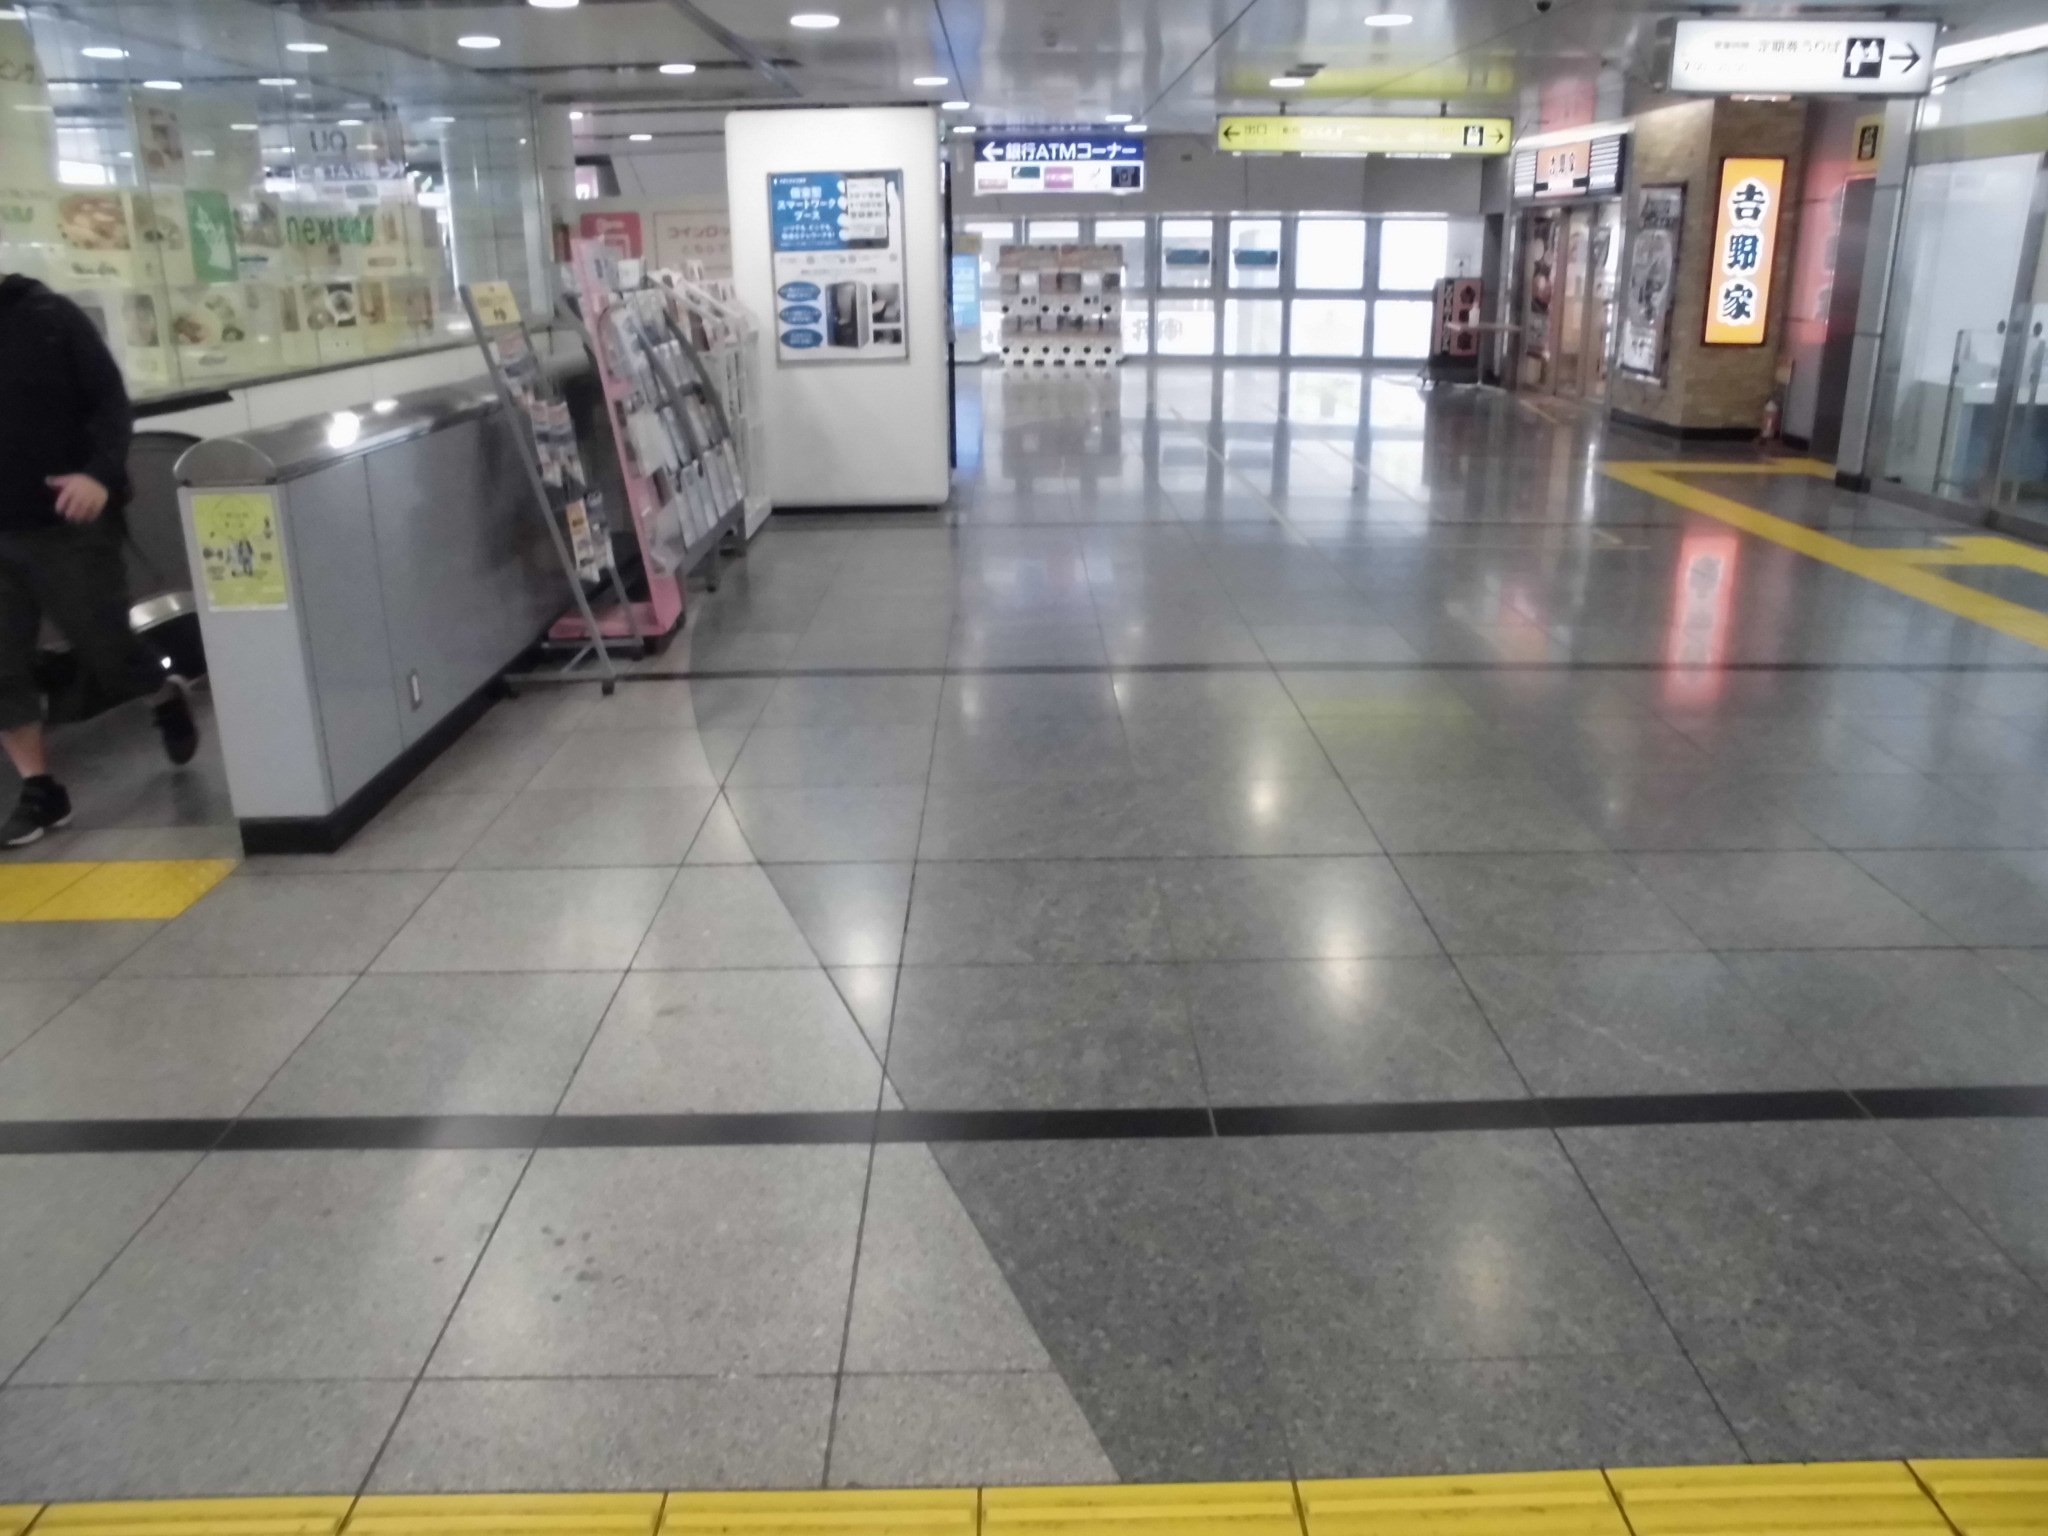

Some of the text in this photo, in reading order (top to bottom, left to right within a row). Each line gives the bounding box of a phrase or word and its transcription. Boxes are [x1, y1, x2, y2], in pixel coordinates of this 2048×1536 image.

[1005, 141, 1137, 161] 銀行ATMコーナー
[776, 198, 836, 211] スマートワーク
